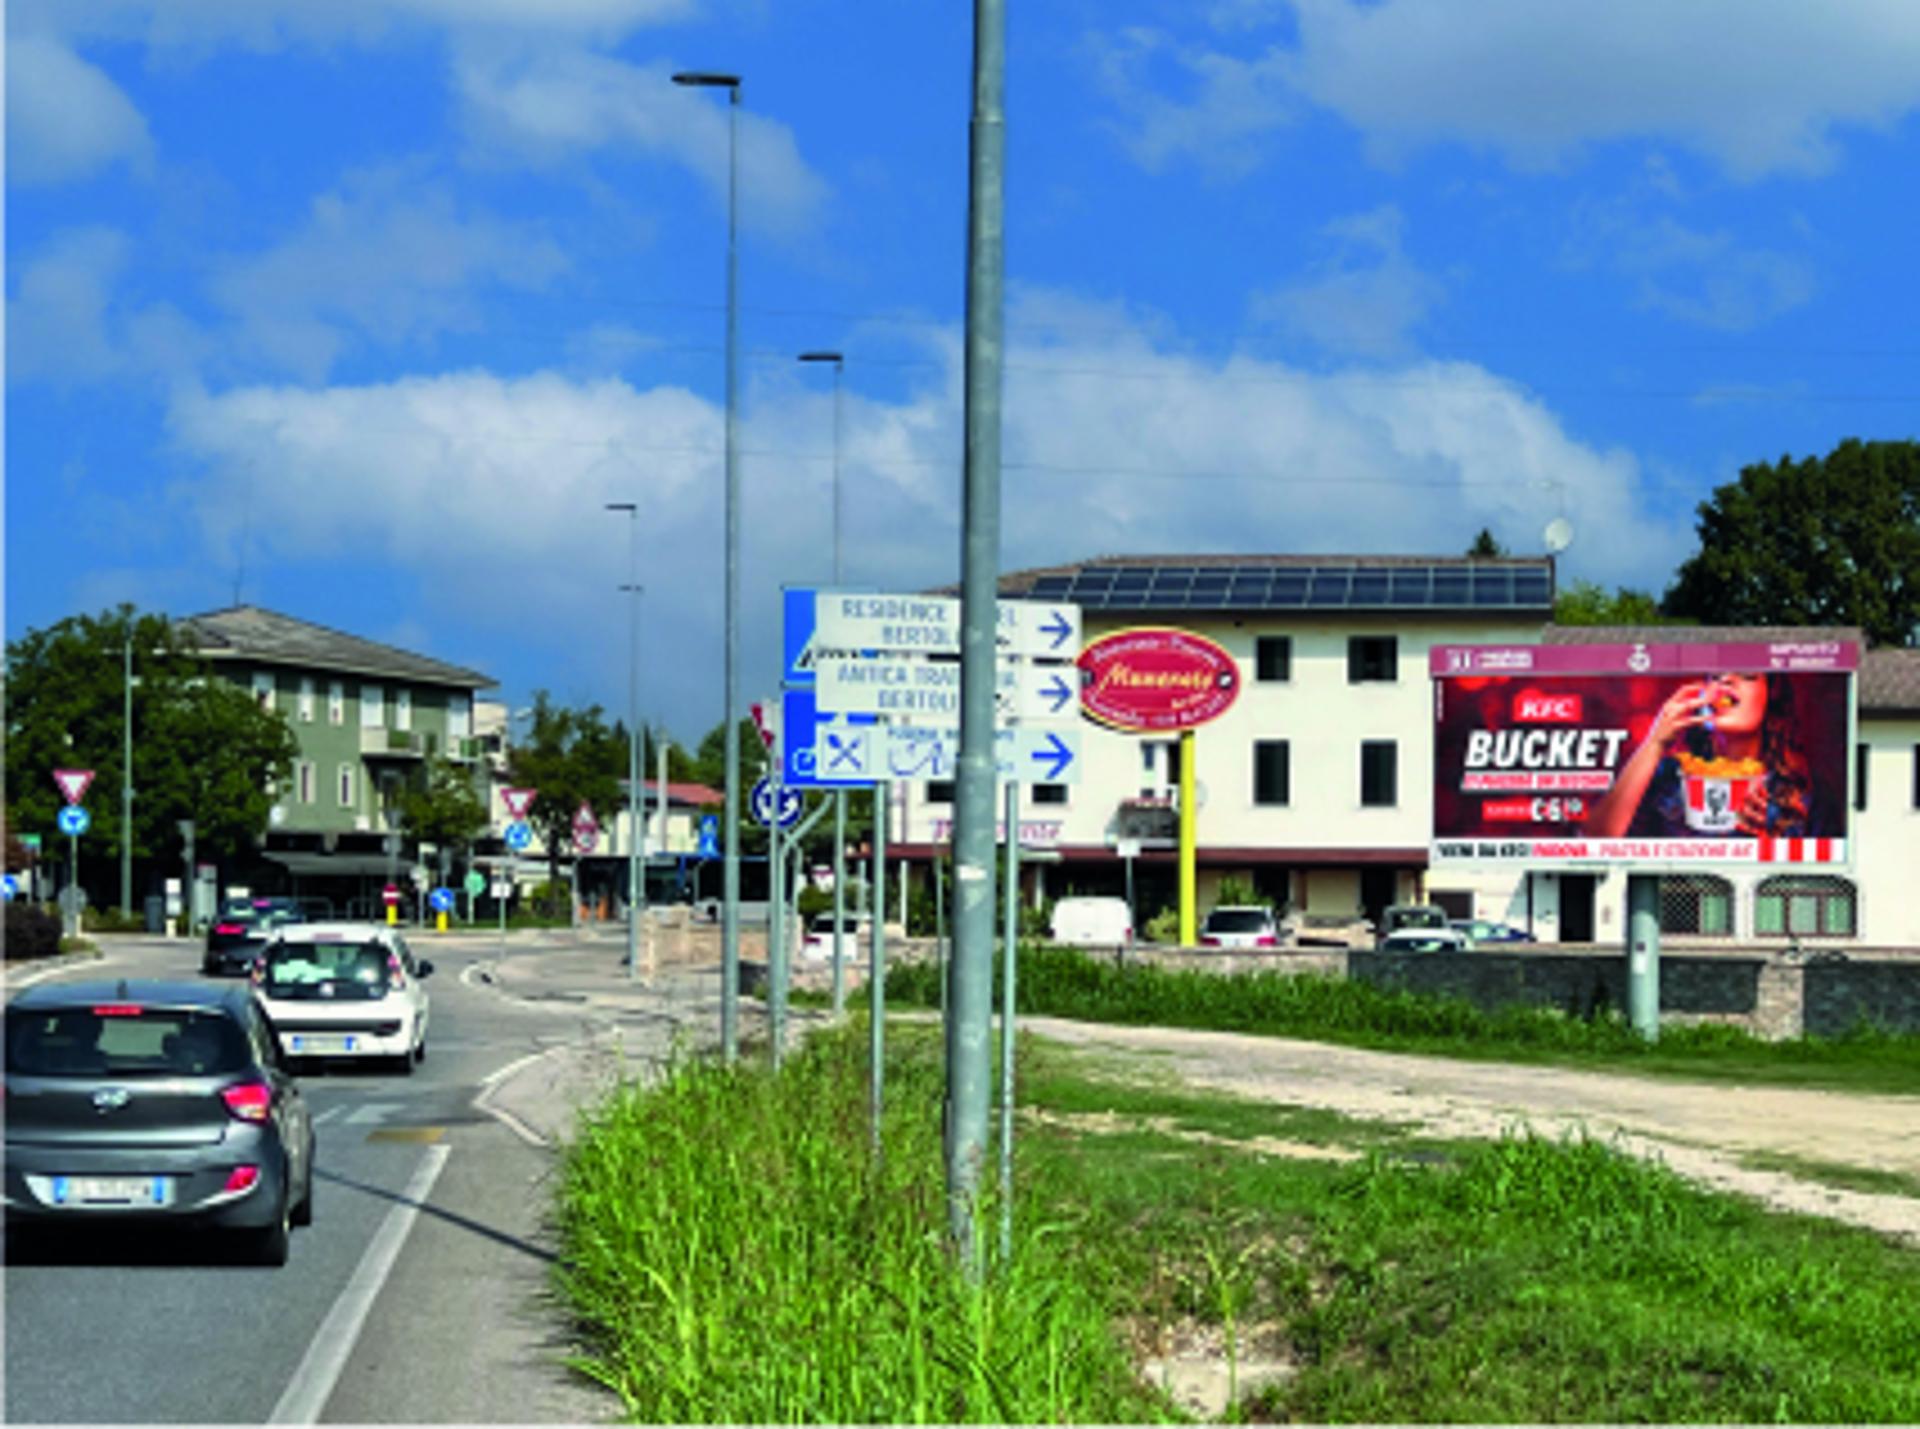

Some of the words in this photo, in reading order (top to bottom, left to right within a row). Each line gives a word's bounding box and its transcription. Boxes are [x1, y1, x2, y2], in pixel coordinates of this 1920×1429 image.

[842, 599, 947, 622] RESIDENCE
[1520, 702, 1574, 718] KFC
[1464, 729, 1627, 768] BUCKET
